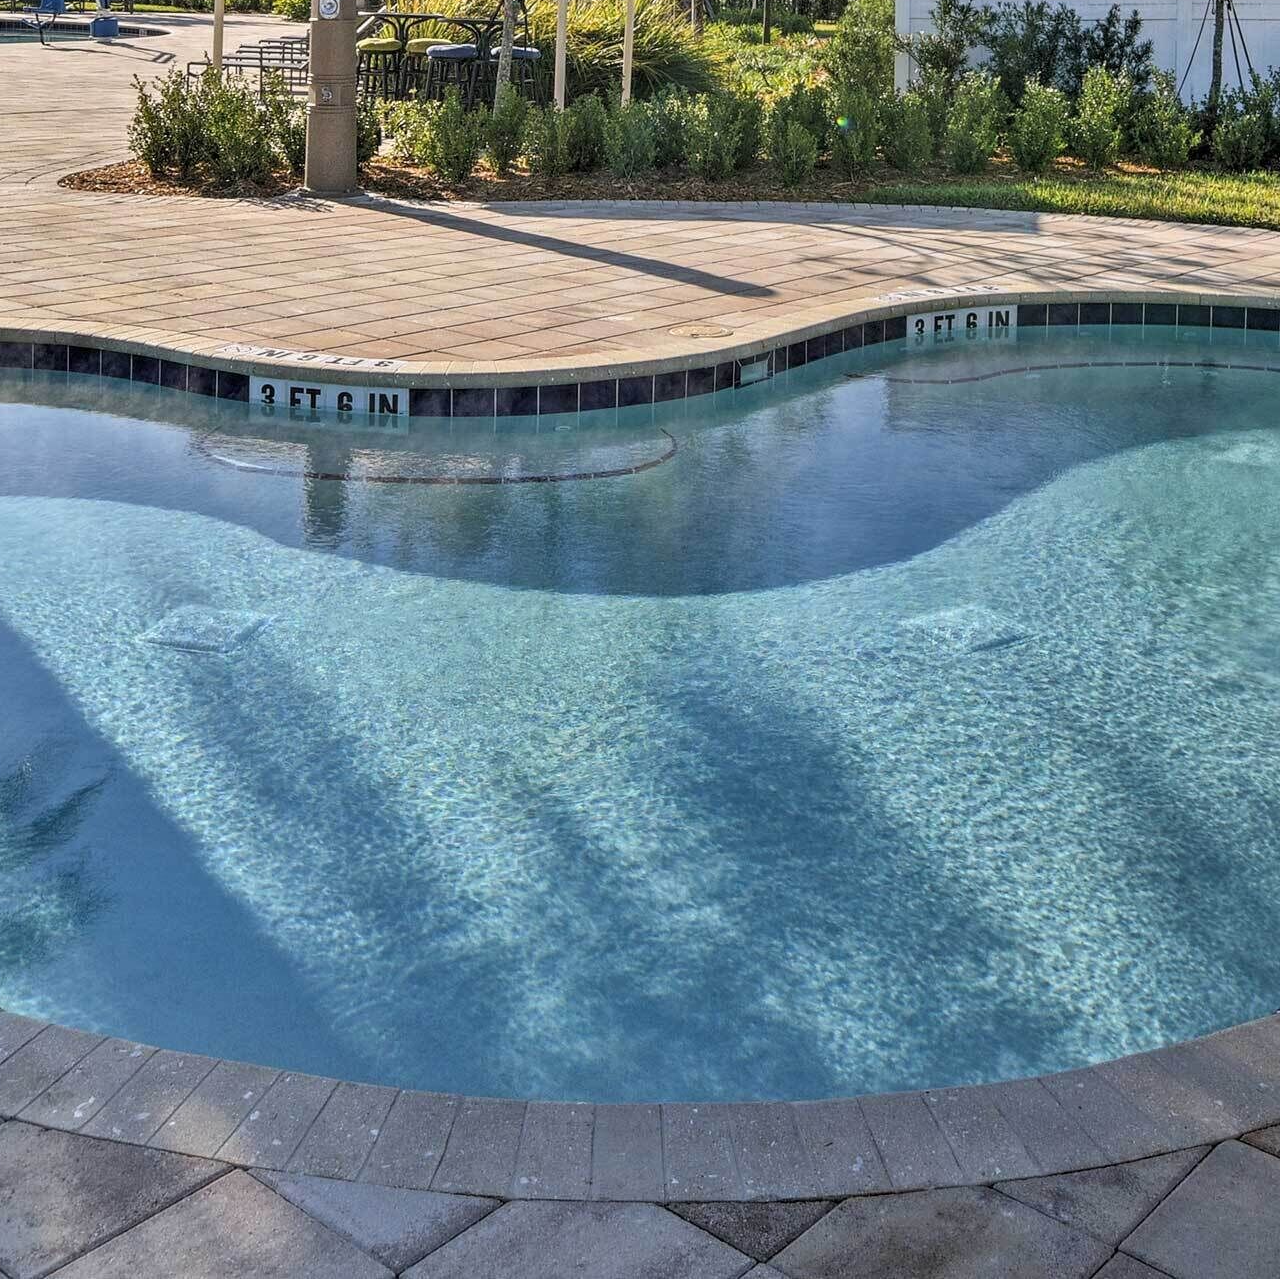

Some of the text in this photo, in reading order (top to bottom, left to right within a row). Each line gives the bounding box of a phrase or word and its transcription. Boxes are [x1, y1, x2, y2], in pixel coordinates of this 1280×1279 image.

[915, 310, 1010, 334] 3 FT 6 IN
[261, 384, 399, 414] 3 FT 6 IN
